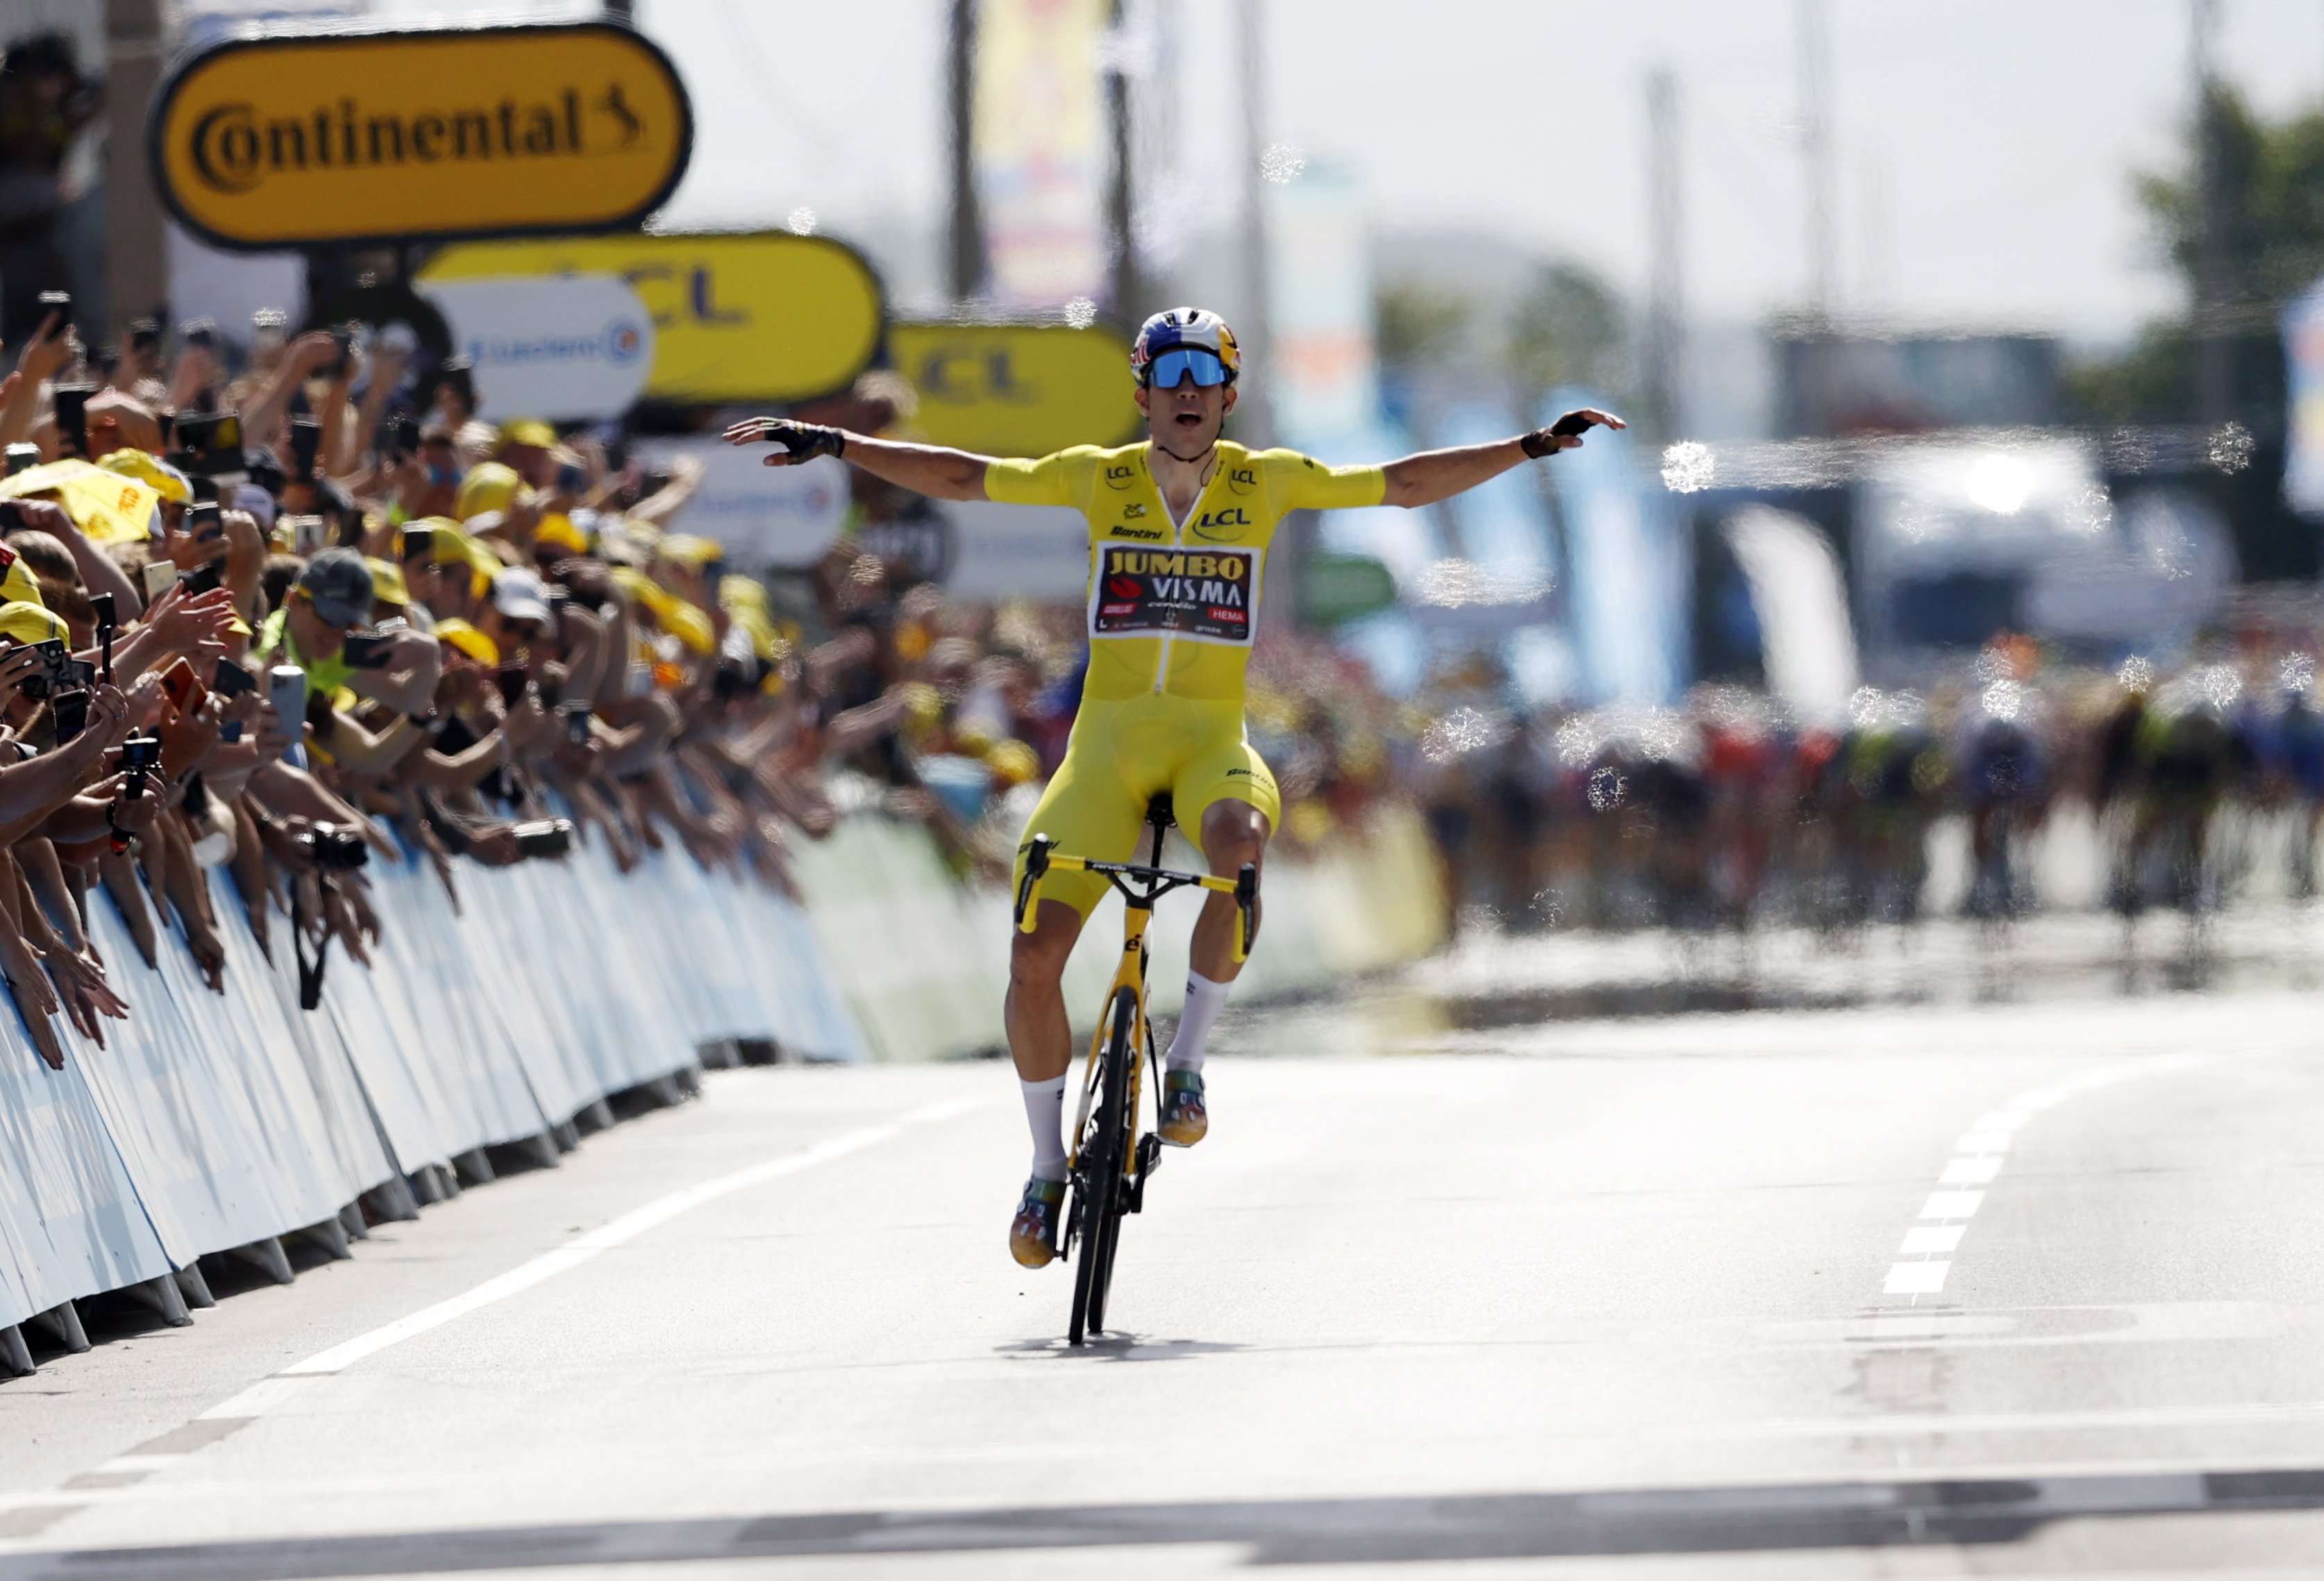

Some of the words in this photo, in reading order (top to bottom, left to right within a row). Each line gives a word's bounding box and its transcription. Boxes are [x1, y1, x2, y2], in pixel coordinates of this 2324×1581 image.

[189, 85, 586, 194] Continental
[1107, 466, 1135, 479] LCL
[1231, 469, 1257, 485] LCL
[1200, 508, 1252, 528] LCL
[1109, 551, 1244, 580] JUMBO
[1152, 577, 1242, 606] VISMA
[1213, 609, 1244, 621] HEMA
